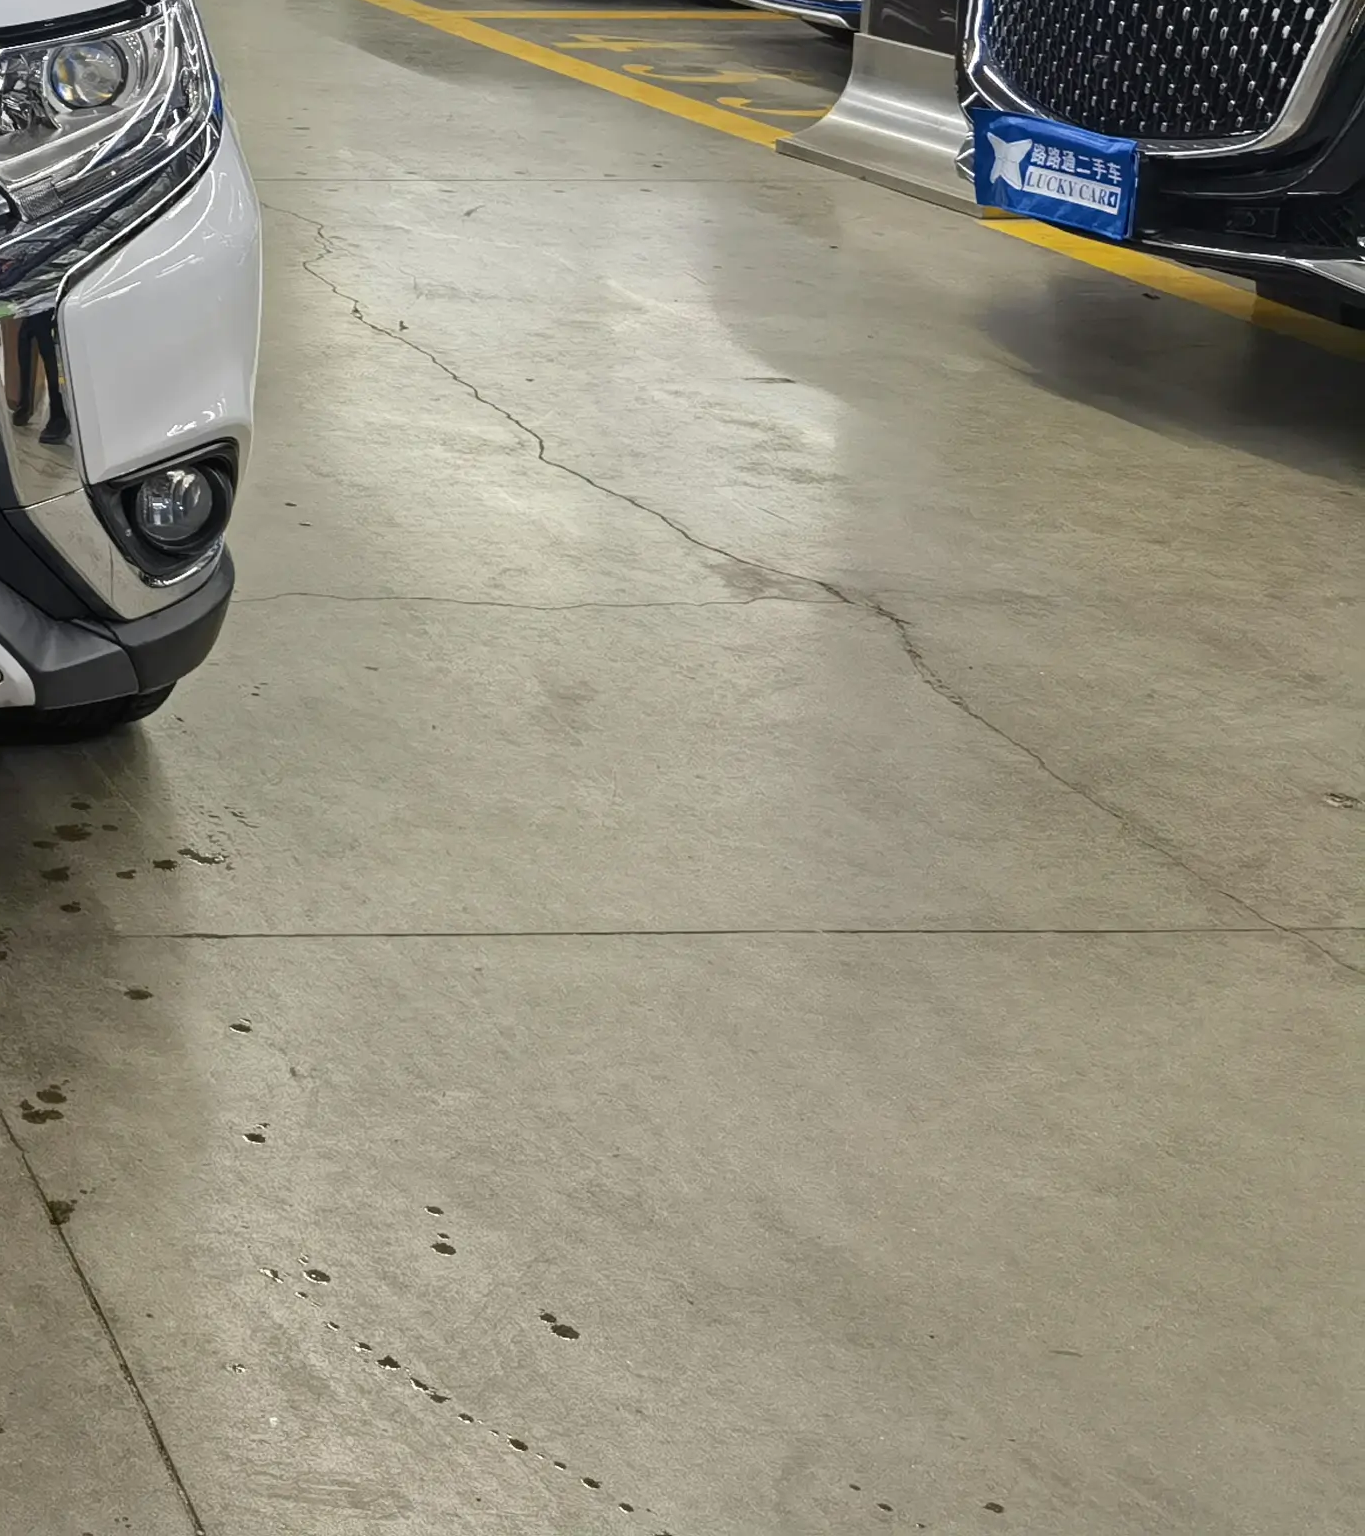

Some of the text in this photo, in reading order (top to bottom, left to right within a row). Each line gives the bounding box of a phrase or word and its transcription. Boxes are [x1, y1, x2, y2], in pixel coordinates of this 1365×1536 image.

[1030, 143, 1122, 184] 路路通二手车
[1027, 171, 1107, 205] LUCKY CAR
